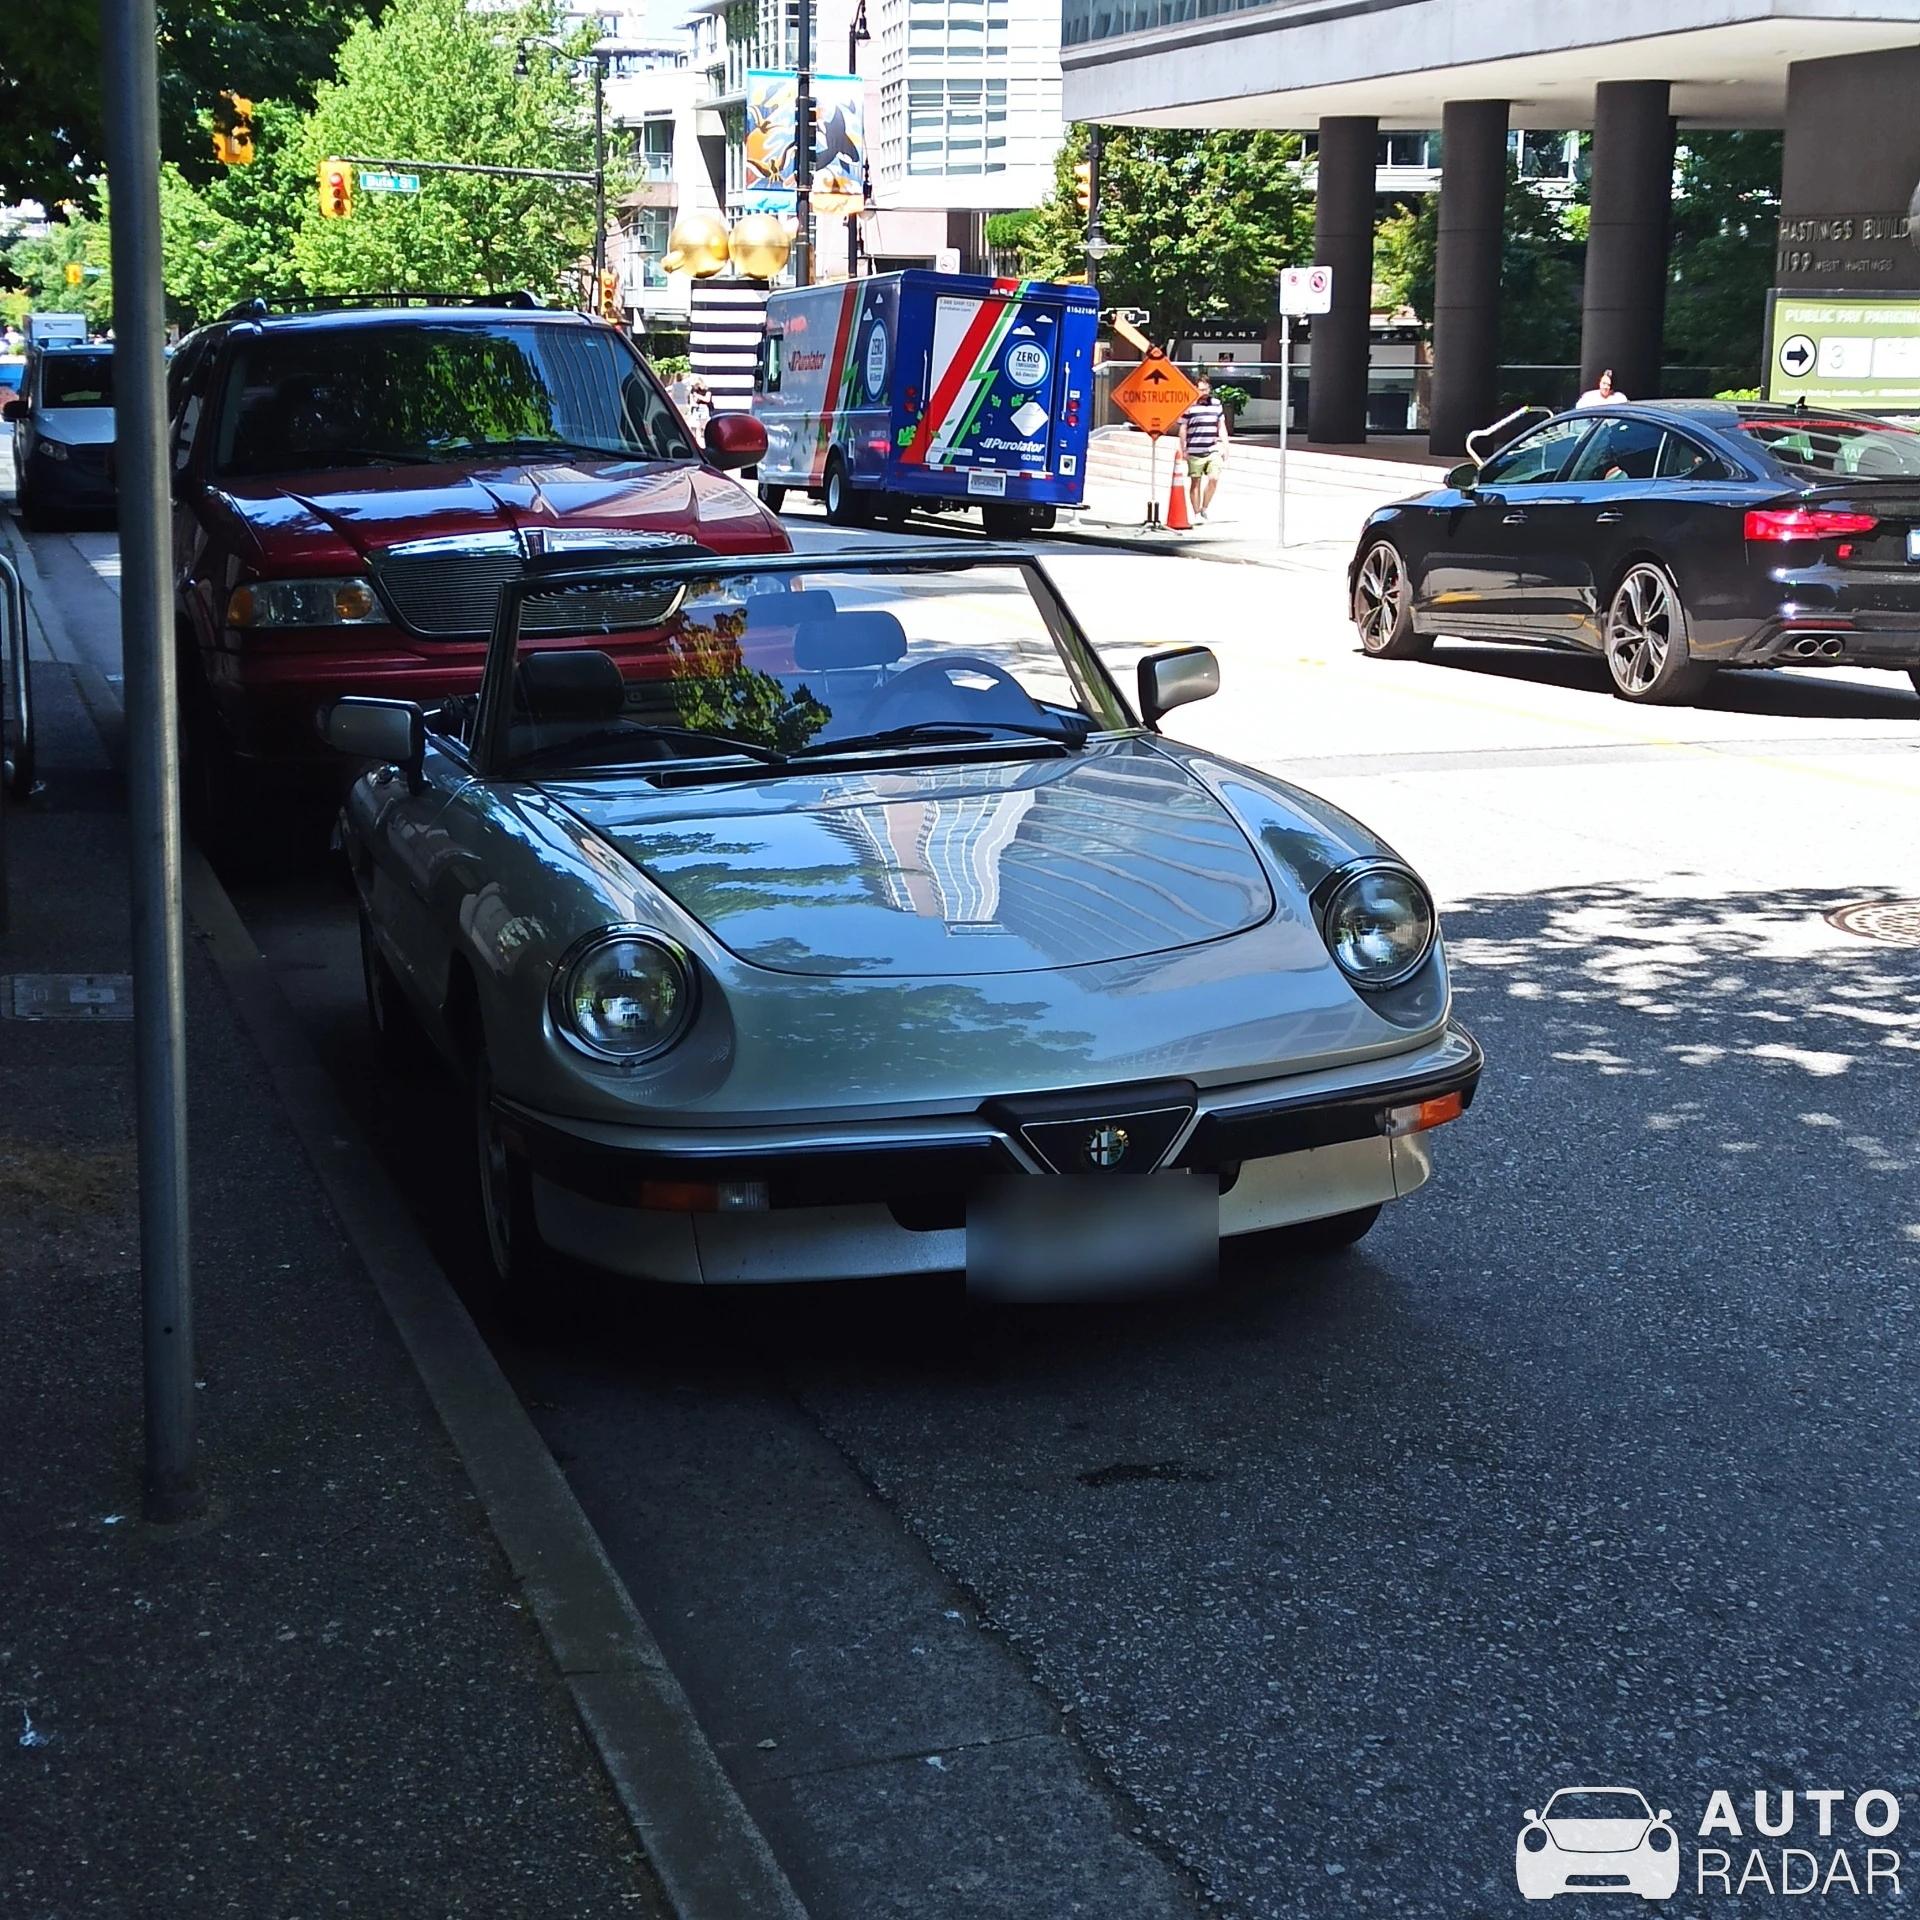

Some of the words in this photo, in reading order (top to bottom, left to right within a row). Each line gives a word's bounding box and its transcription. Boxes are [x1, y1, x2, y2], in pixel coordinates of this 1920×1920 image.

[1779, 219, 1853, 241] HASTINGS
[1862, 217, 1911, 240] BUILD
[1776, 252, 1812, 272] 1199
[1785, 309, 1835, 322] PUBLIC
[1837, 310, 1863, 323] PAY
[1016, 350, 1041, 364] ZERO
[1122, 390, 1190, 403] CONSTRUCTION
[990, 437, 1046, 453] Purolator
